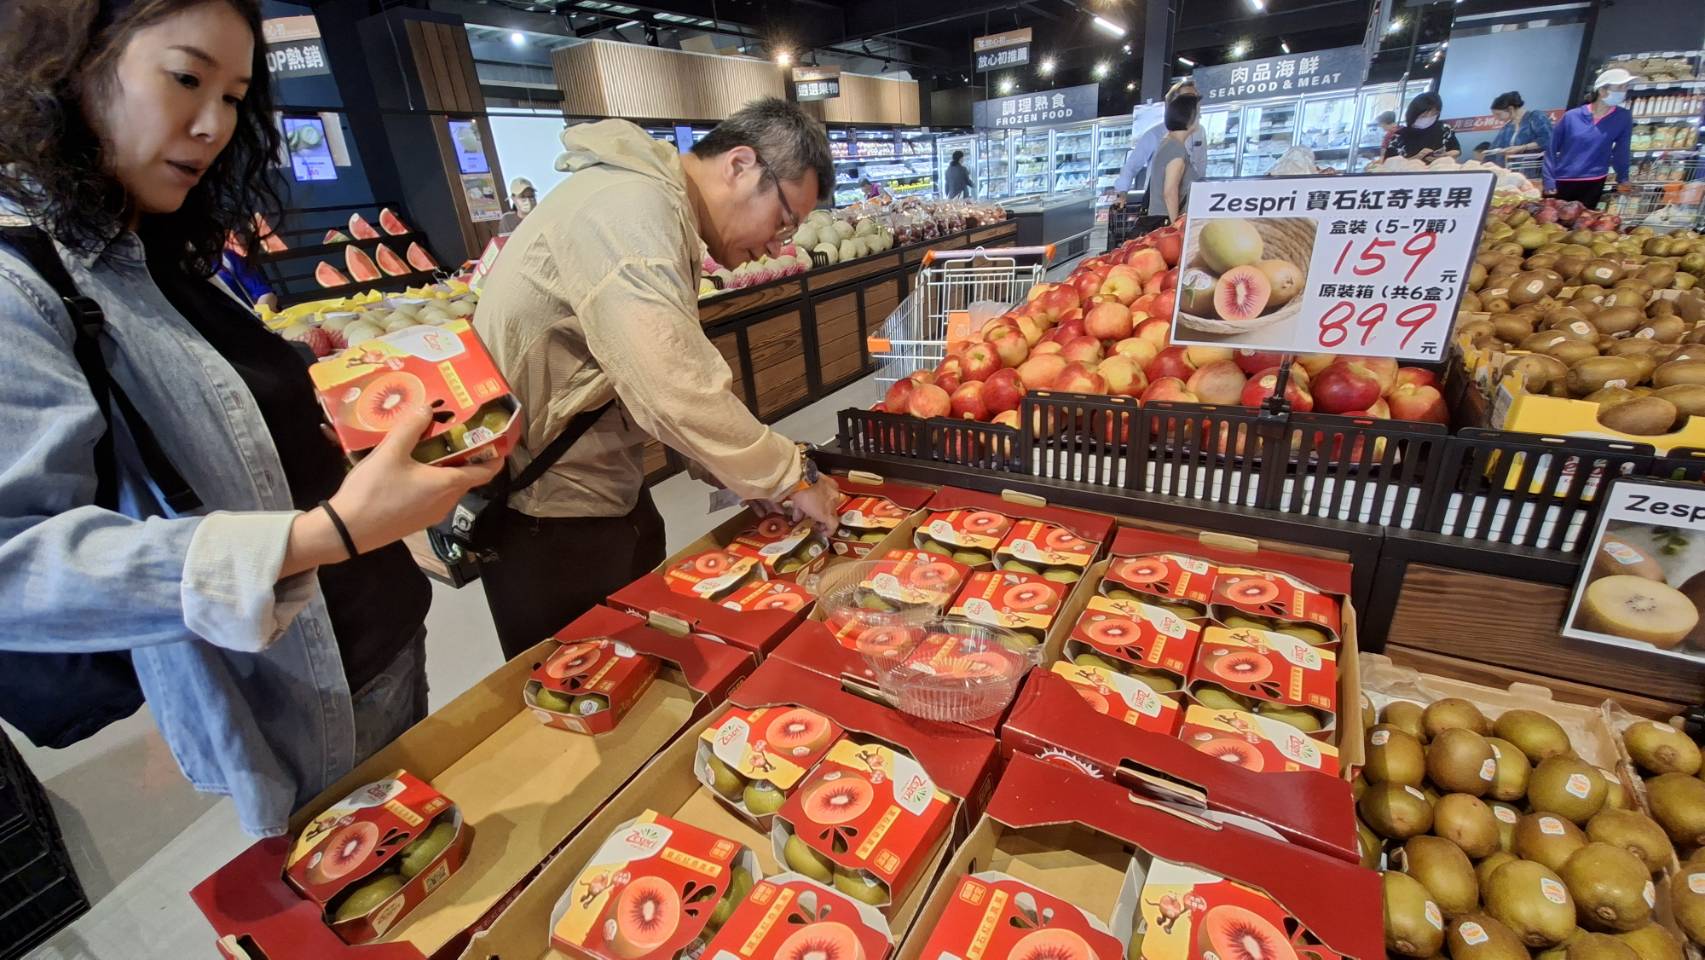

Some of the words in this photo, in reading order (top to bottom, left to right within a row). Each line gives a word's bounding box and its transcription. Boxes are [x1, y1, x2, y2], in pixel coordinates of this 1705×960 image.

[1231, 55, 1320, 85] 肉品海鮮
[1209, 82, 1278, 98] SEAFOOD
[1282, 79, 1293, 90] &
[1297, 72, 1342, 88] MEAT
[995, 113, 1038, 126] FROZEN
[1042, 108, 1073, 120] FOOD
[1002, 92, 1065, 116] 調理熟食
[1209, 190, 1298, 216] Zespri
[1306, 186, 1473, 212] 寶石紅奇異果
[1333, 231, 1437, 283] 159
[1440, 270, 1458, 284] 元
[1317, 301, 1437, 350] 899
[1421, 342, 1437, 355] 元
[903, 775, 927, 803] Zespri
[625, 830, 658, 849] Zespri
